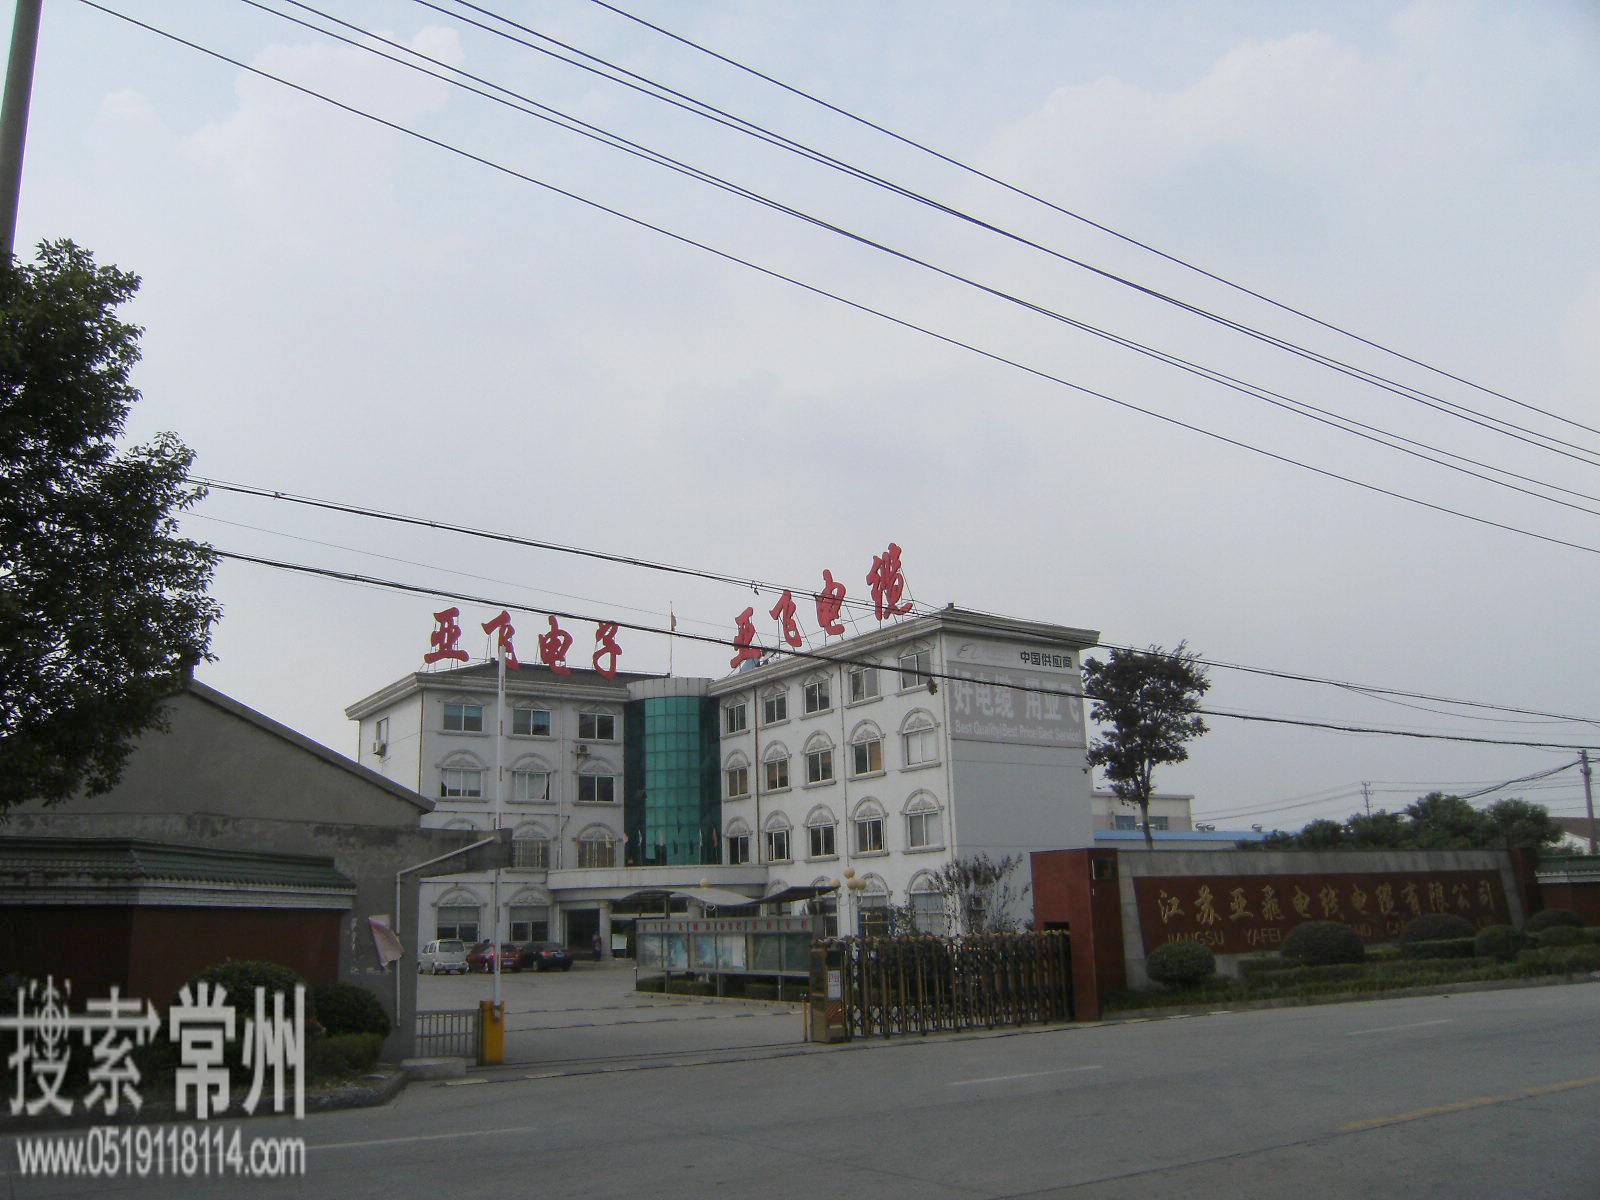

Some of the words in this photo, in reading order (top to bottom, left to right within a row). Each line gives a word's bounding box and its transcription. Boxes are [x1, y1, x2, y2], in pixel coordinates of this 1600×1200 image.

[730, 542, 913, 669] 亚飞电缆
[424, 606, 622, 682] 亚飞电子
[1020, 650, 1073, 669] 中国供应商
